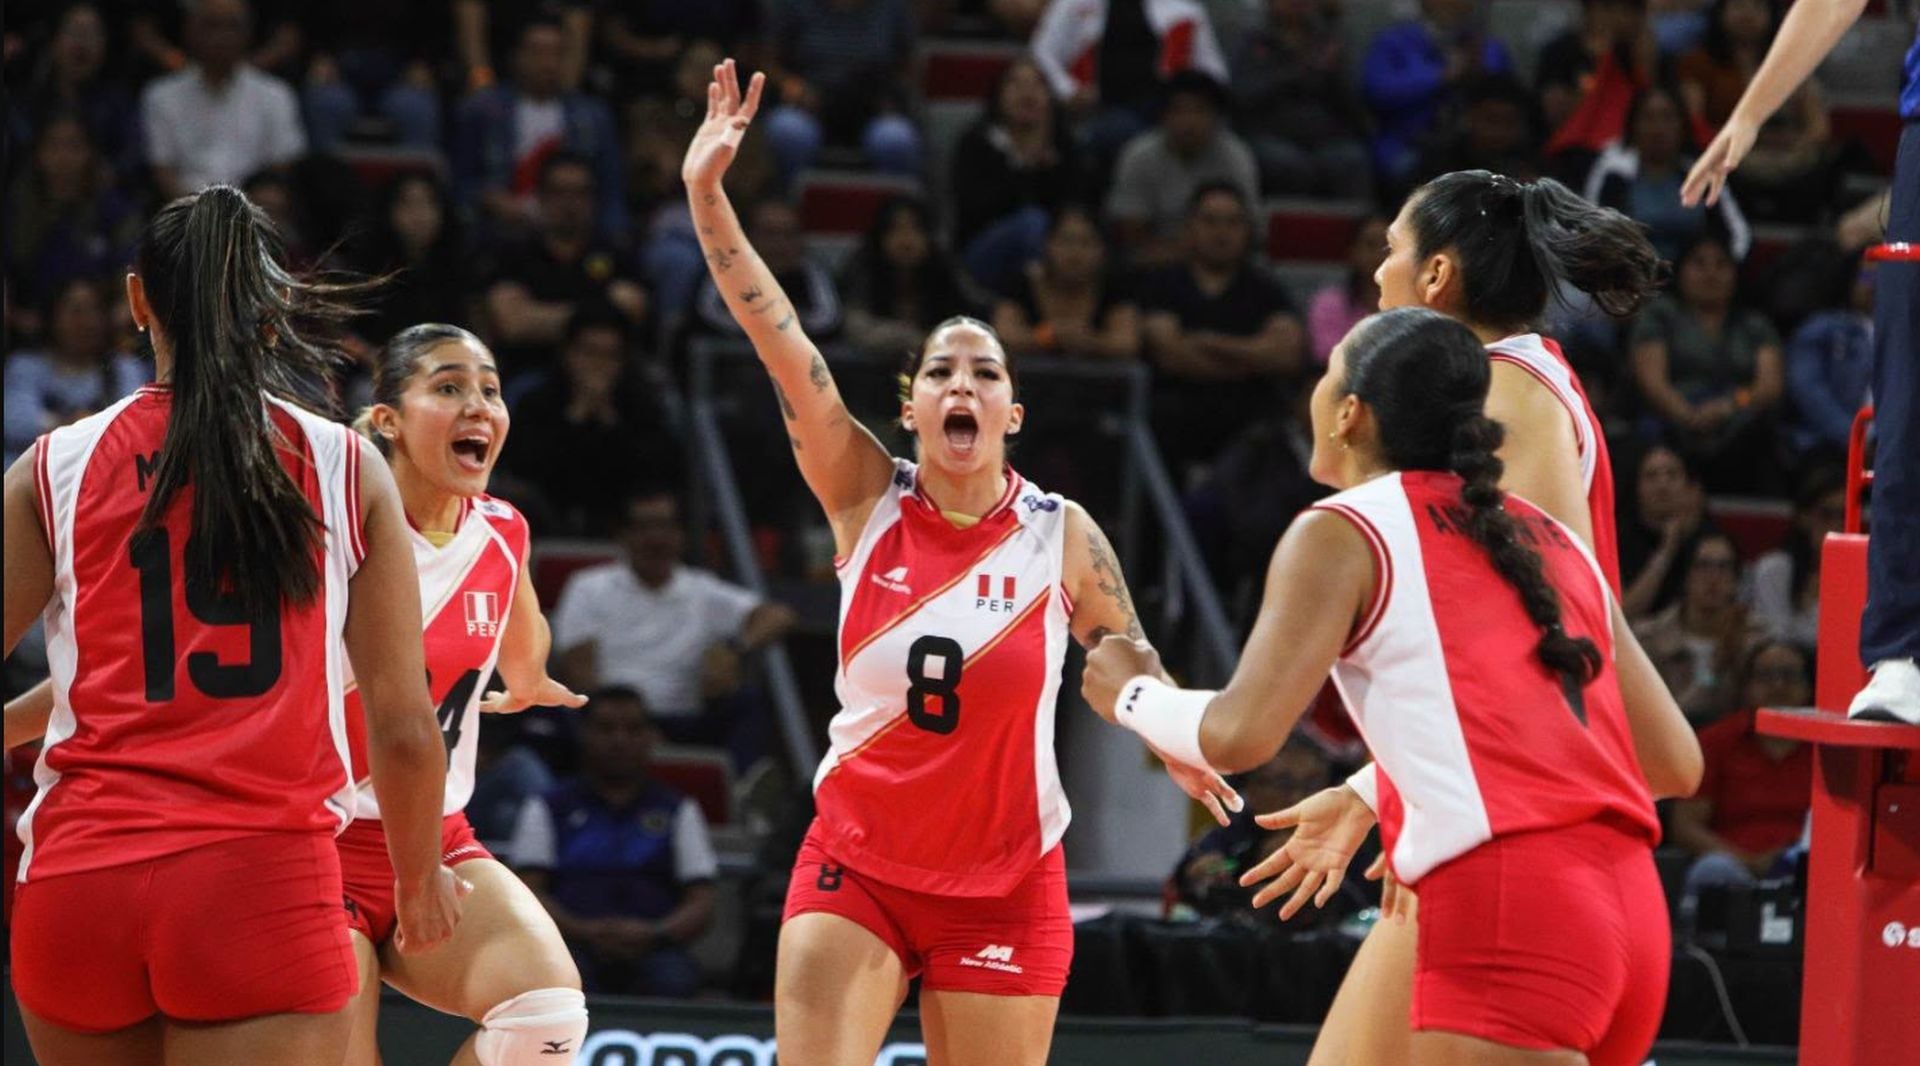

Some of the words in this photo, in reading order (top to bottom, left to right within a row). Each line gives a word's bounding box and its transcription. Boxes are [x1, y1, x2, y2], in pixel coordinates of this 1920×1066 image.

[976, 599, 1014, 612] PER
[466, 622, 498, 637] PER
[906, 635, 964, 735] 8
[816, 863, 845, 892] 8
